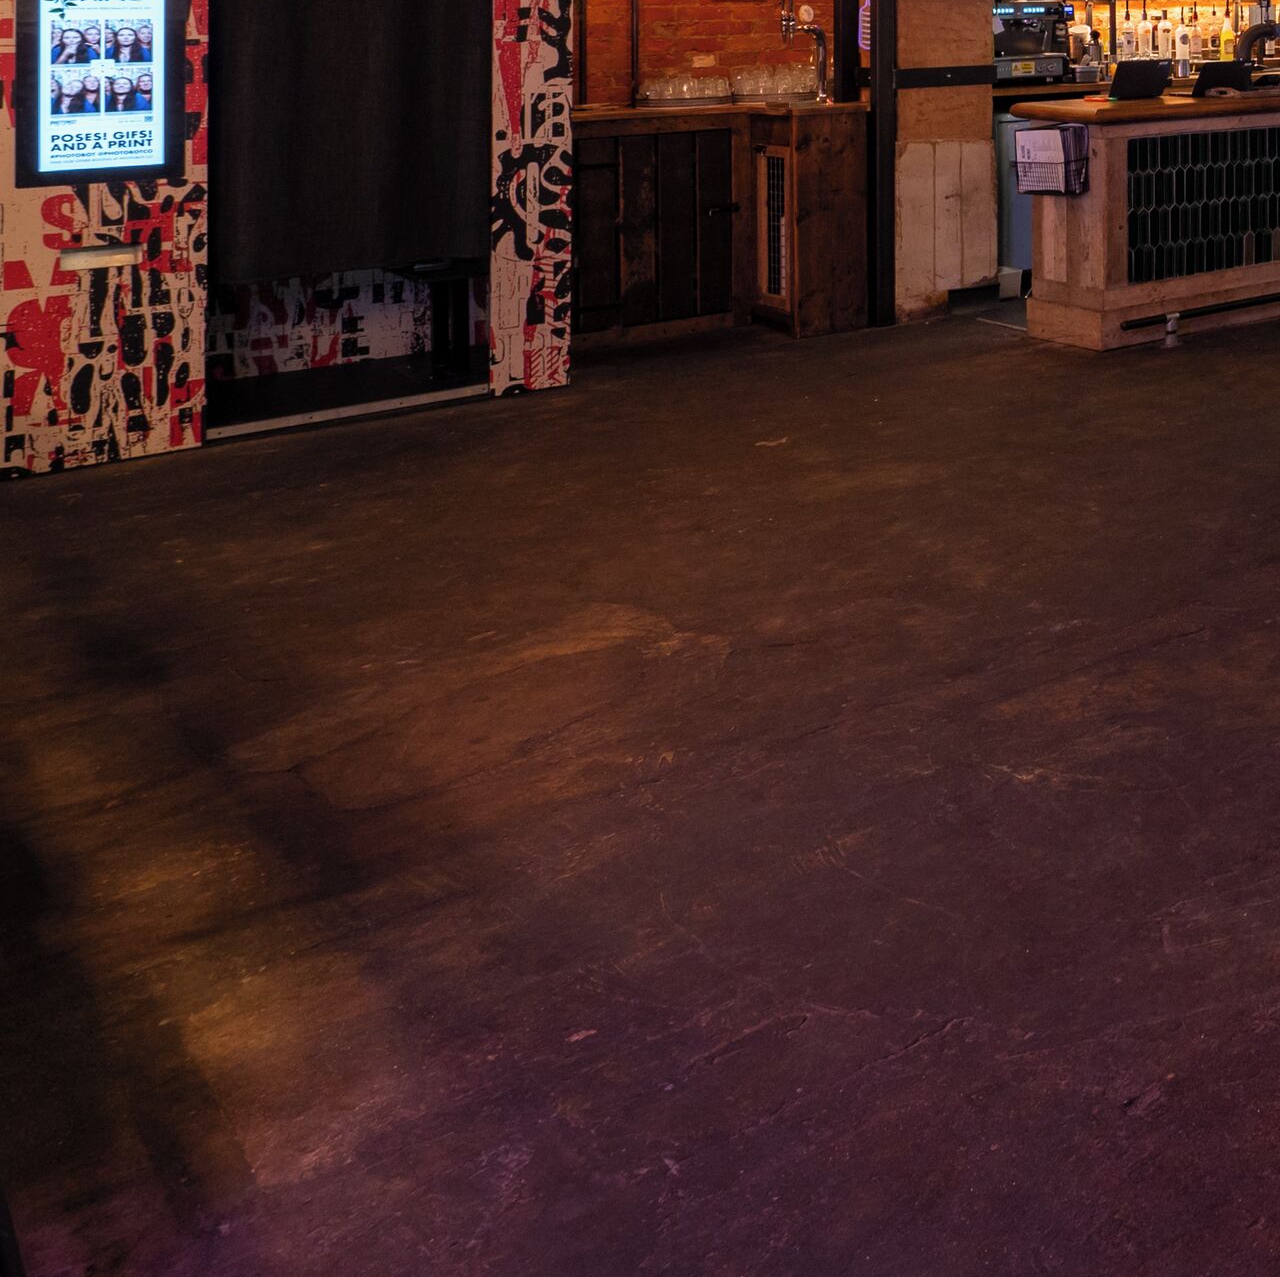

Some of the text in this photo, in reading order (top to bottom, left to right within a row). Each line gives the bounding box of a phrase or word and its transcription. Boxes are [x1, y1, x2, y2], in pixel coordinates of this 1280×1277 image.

[51, 130, 153, 143] POSES! GIFS!
[50, 139, 153, 152] AND A PRINT
